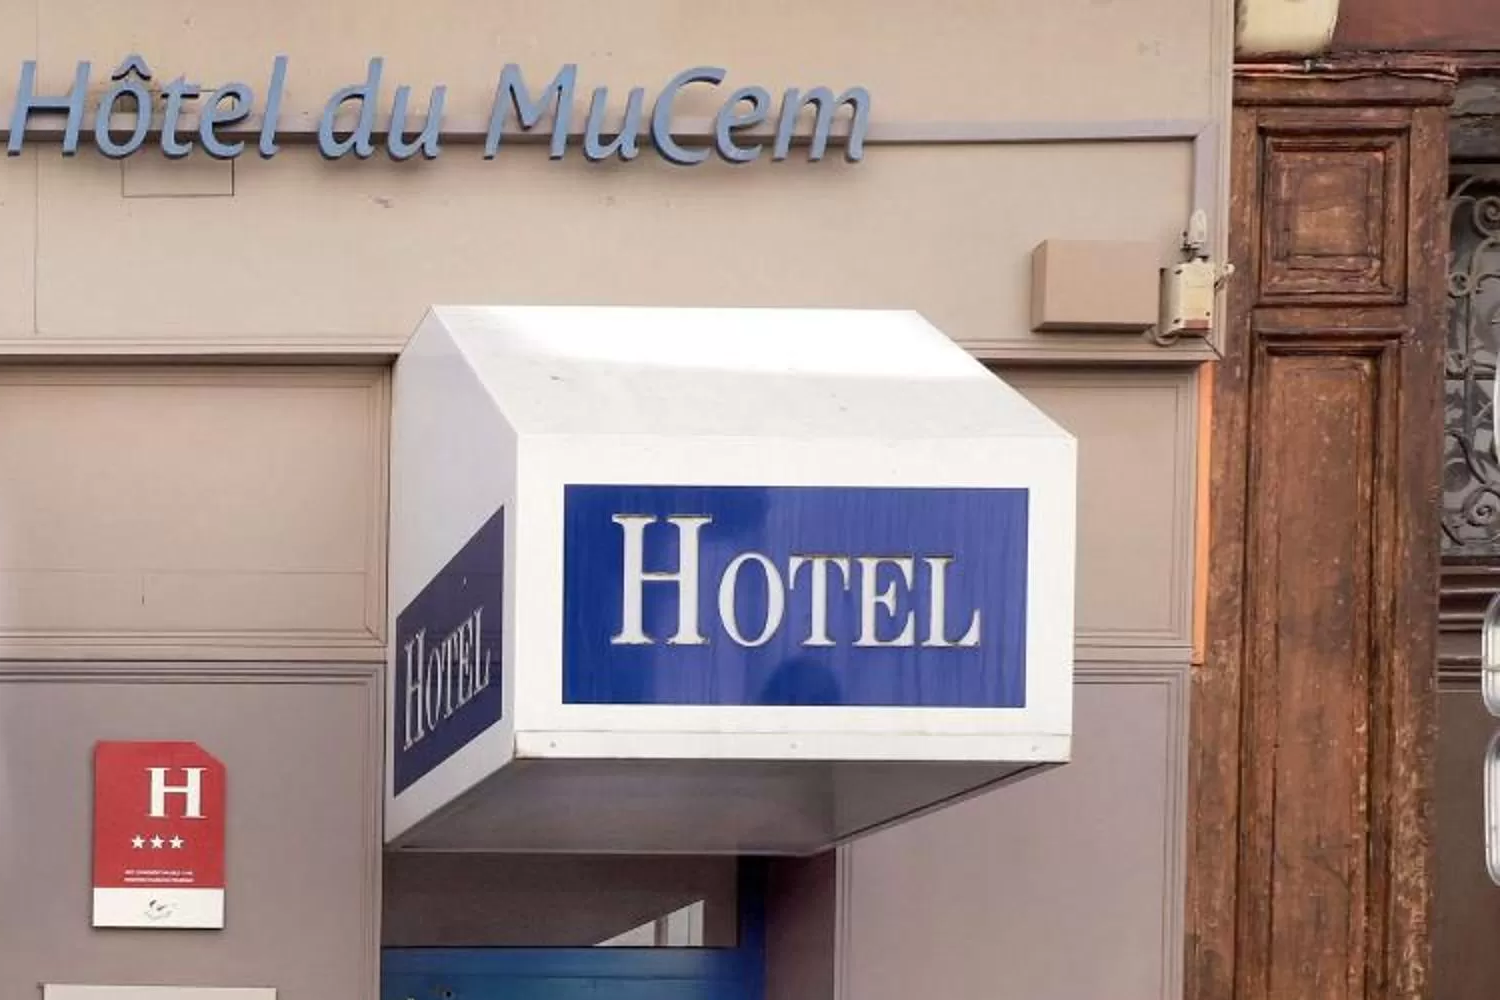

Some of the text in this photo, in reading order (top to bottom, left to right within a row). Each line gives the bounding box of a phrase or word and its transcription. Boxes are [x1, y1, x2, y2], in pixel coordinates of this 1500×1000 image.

[6, 55, 290, 159] Hôtel
[315, 57, 448, 162] du
[483, 62, 873, 163] MuCem
[610, 512, 982, 648] HOTEL
[403, 606, 491, 752] HOTEL
[144, 766, 208, 819] H
